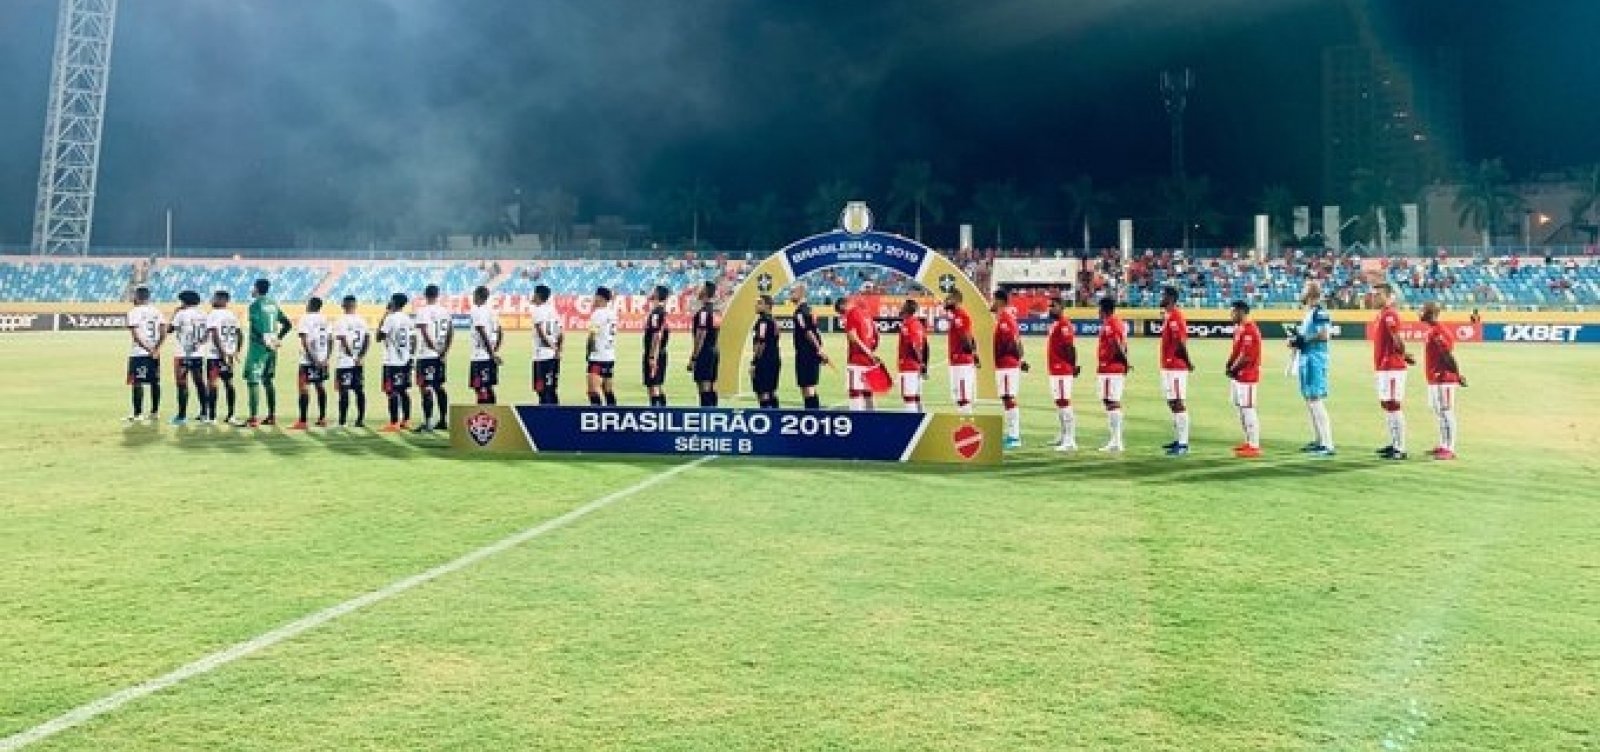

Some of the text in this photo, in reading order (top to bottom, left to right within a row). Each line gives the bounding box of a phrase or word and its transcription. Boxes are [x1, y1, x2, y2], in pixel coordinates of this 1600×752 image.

[792, 240, 919, 263] BRASILEIRÃO 2019
[1502, 325, 1582, 341] 1XBET
[580, 409, 852, 435] BRASILEIRÃO 2019
[674, 434, 753, 453] SÉRIE B
